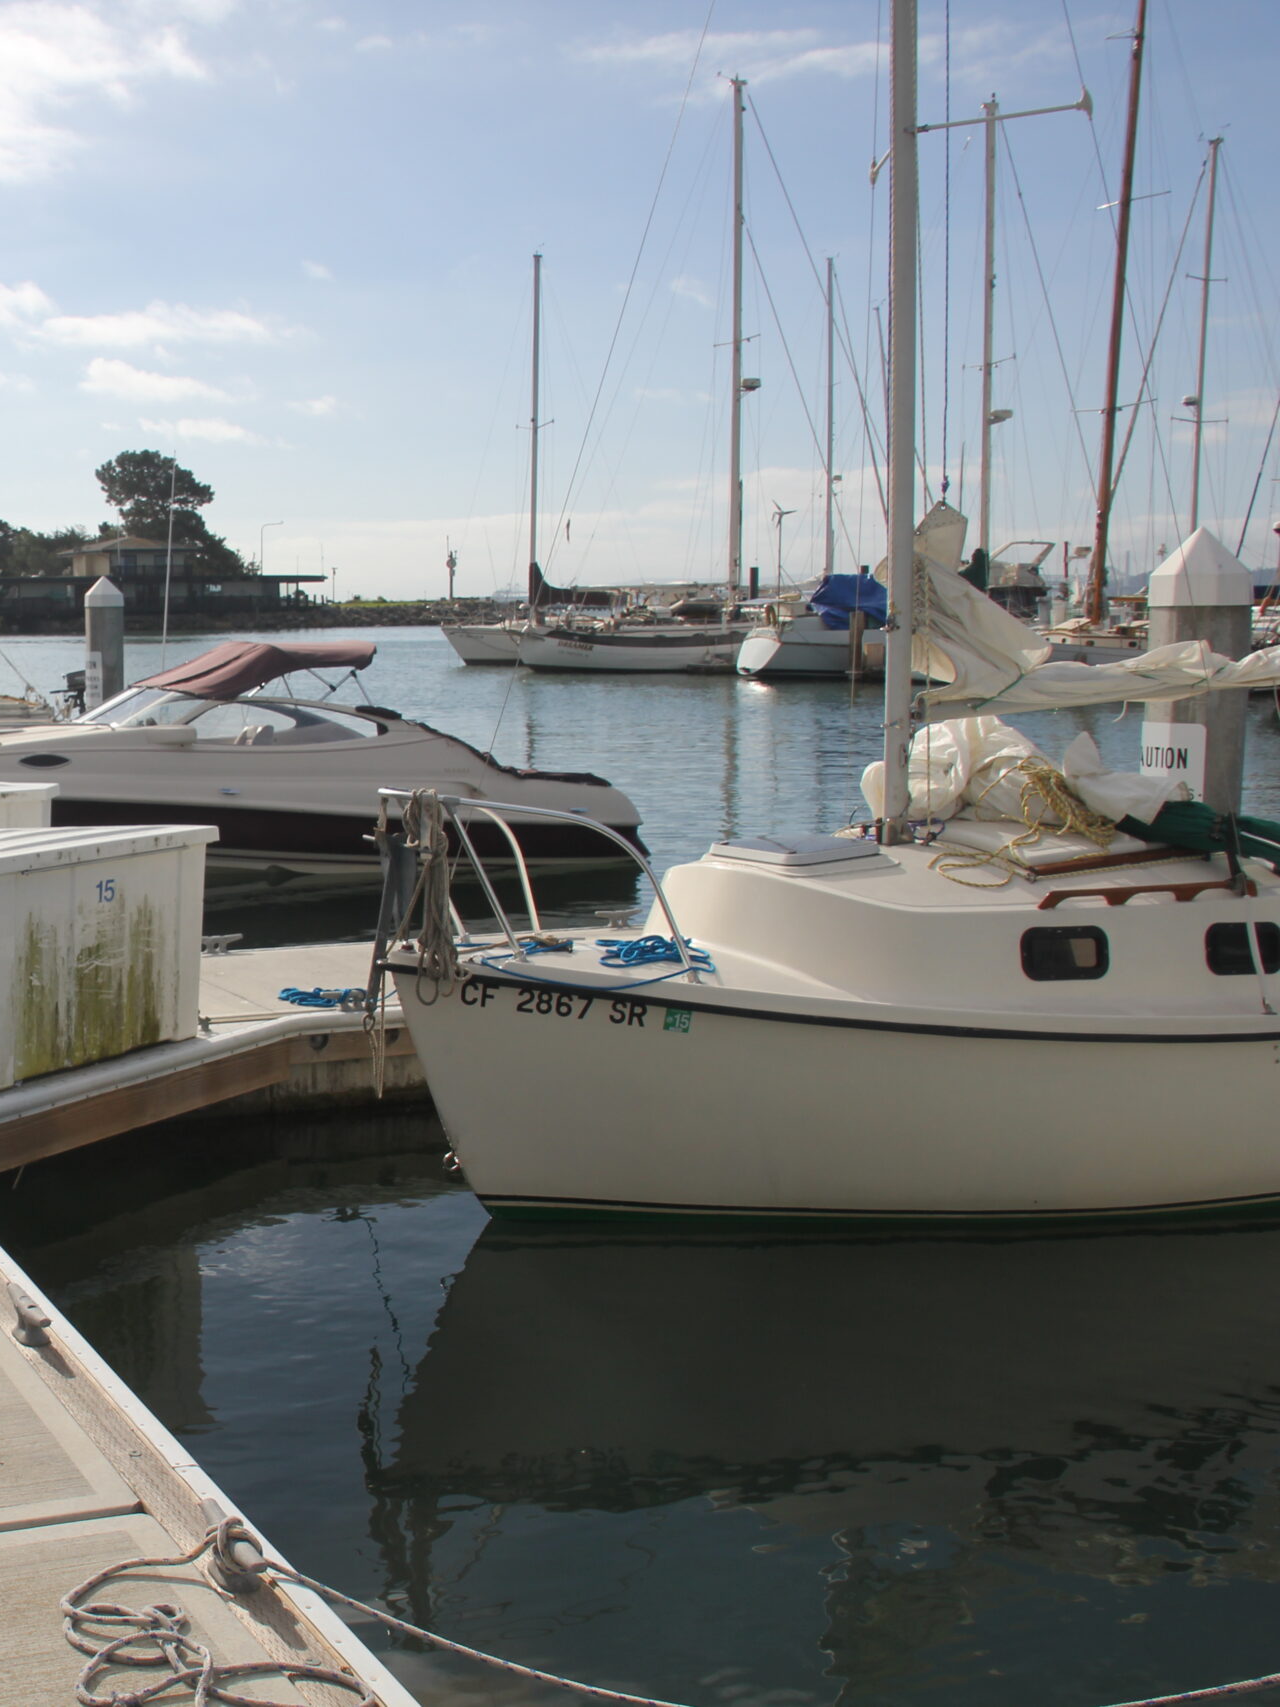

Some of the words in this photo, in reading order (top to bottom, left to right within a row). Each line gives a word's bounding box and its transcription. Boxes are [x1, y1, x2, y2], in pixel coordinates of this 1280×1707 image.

[96, 879, 115, 903] 15
[460, 982, 500, 1008] CF
[516, 988, 596, 1020] 2867
[609, 1000, 648, 1028] SR
[674, 1013, 690, 1029] 15
